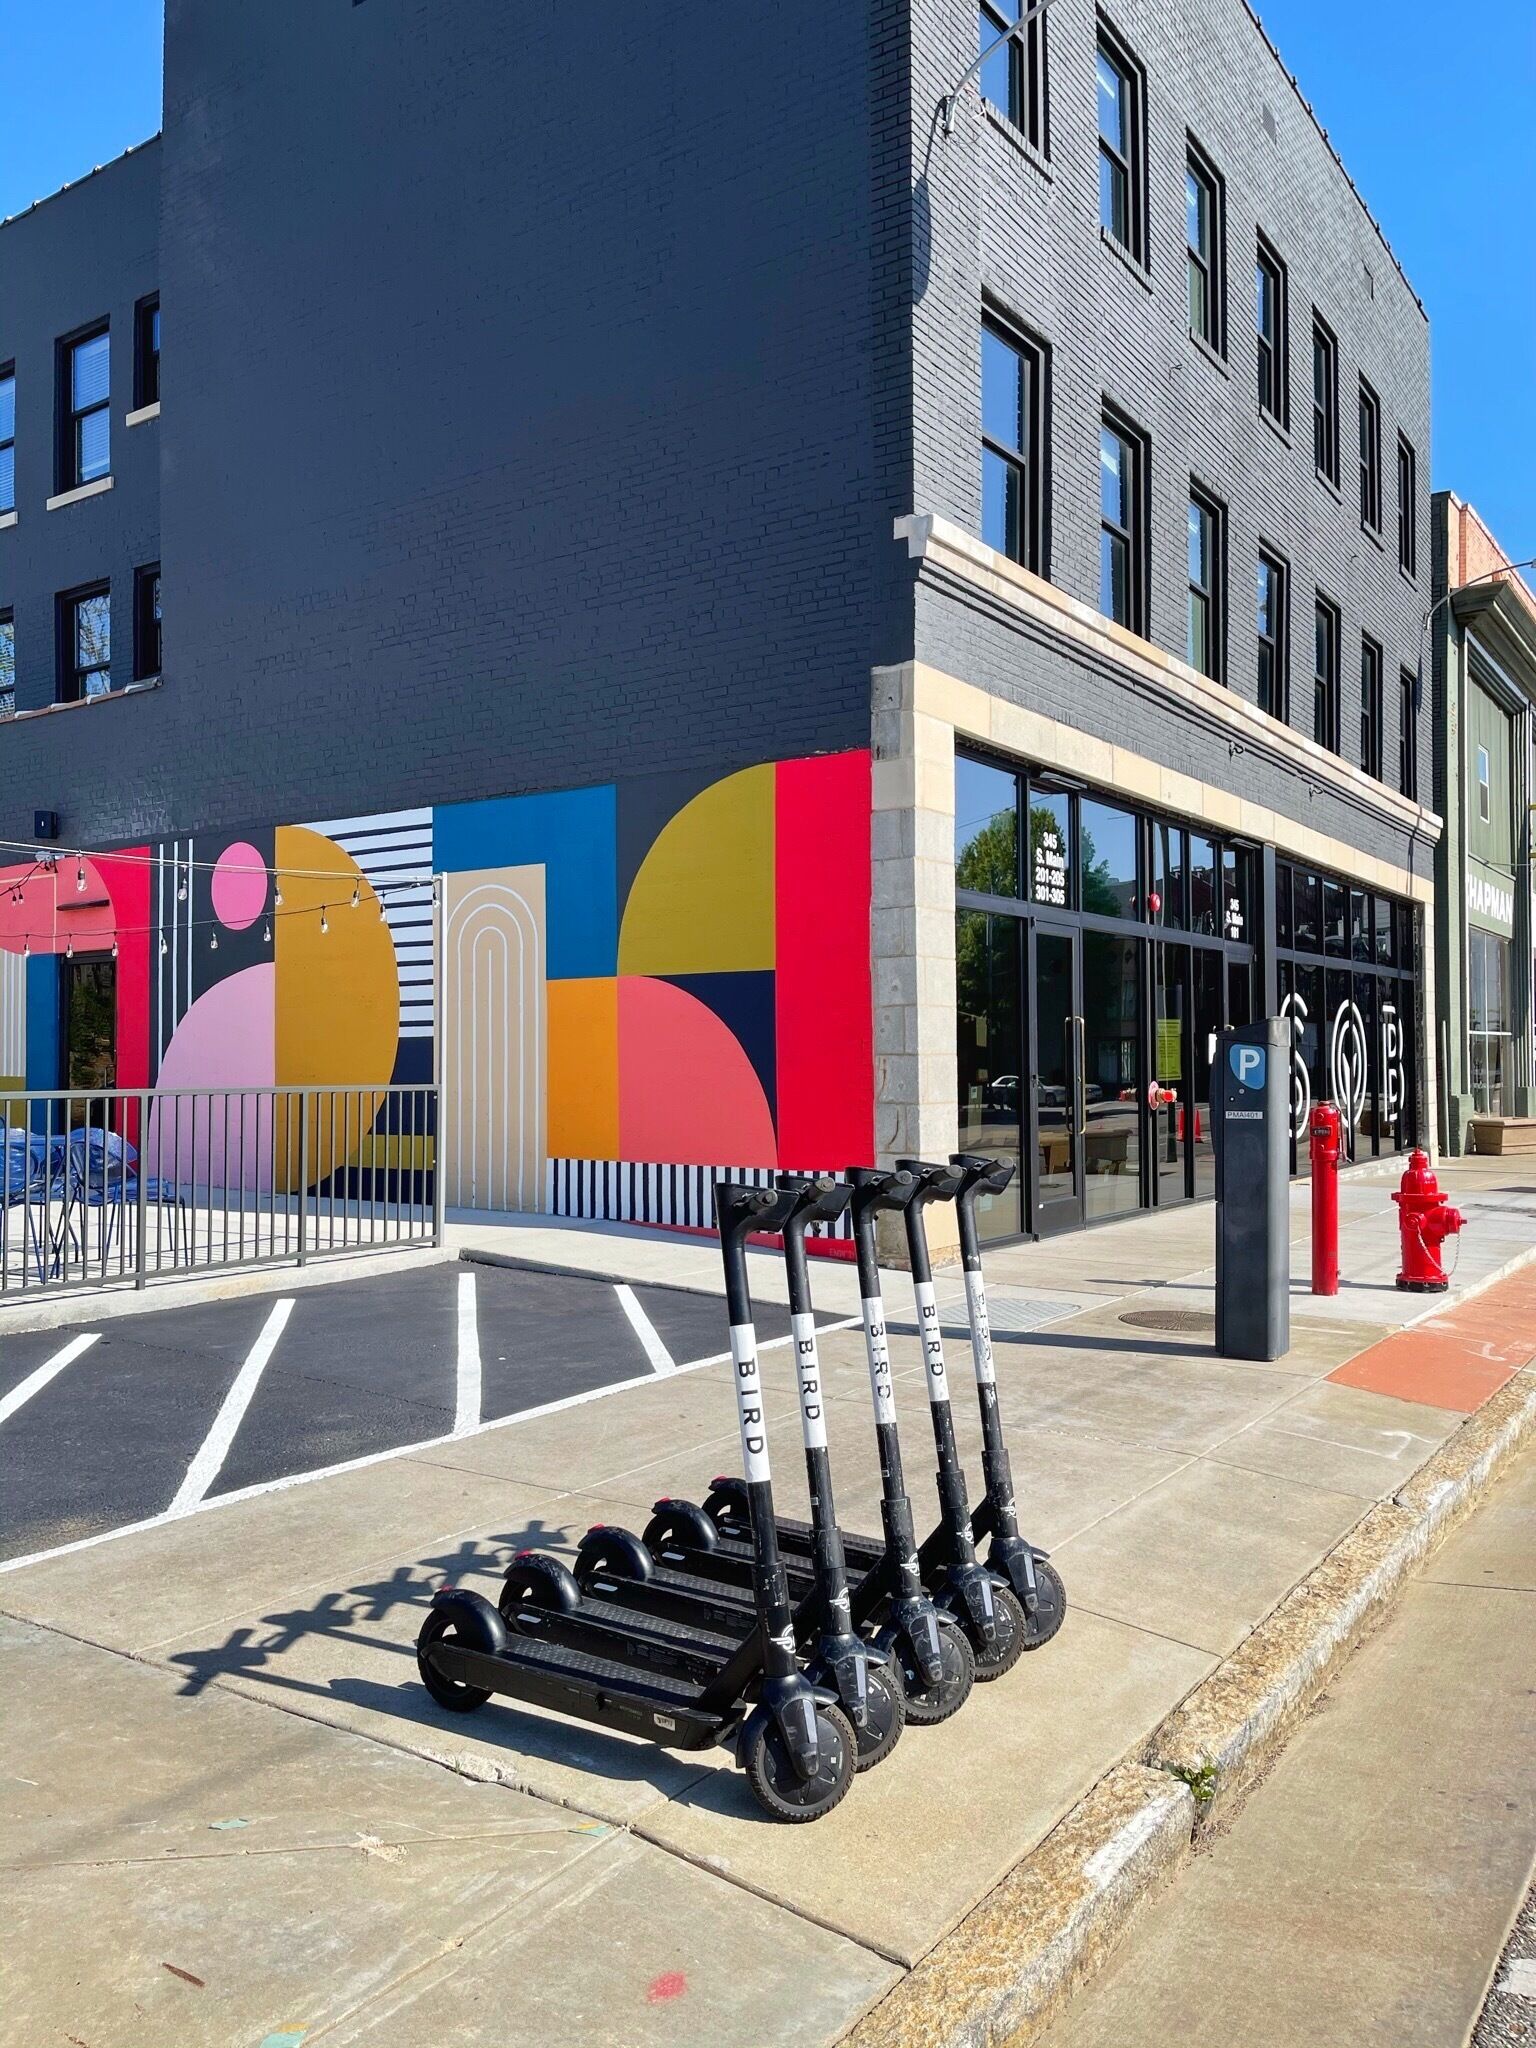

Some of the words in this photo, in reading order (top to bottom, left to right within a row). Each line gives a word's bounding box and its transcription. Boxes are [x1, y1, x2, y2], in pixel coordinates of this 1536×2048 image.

[1043, 831, 1057, 850] 345
[1036, 847, 1045, 865] S.
[1046, 850, 1064, 869] Main
[1035, 866, 1065, 887] 201-205
[1035, 884, 1065, 905] 301-305
[1239, 1048, 1260, 1080] P
[922, 1303, 944, 1377] BIRD
[869, 1321, 891, 1399] BIRD
[798, 1336, 821, 1420] BIRD
[738, 1358, 764, 1455] BIRD
